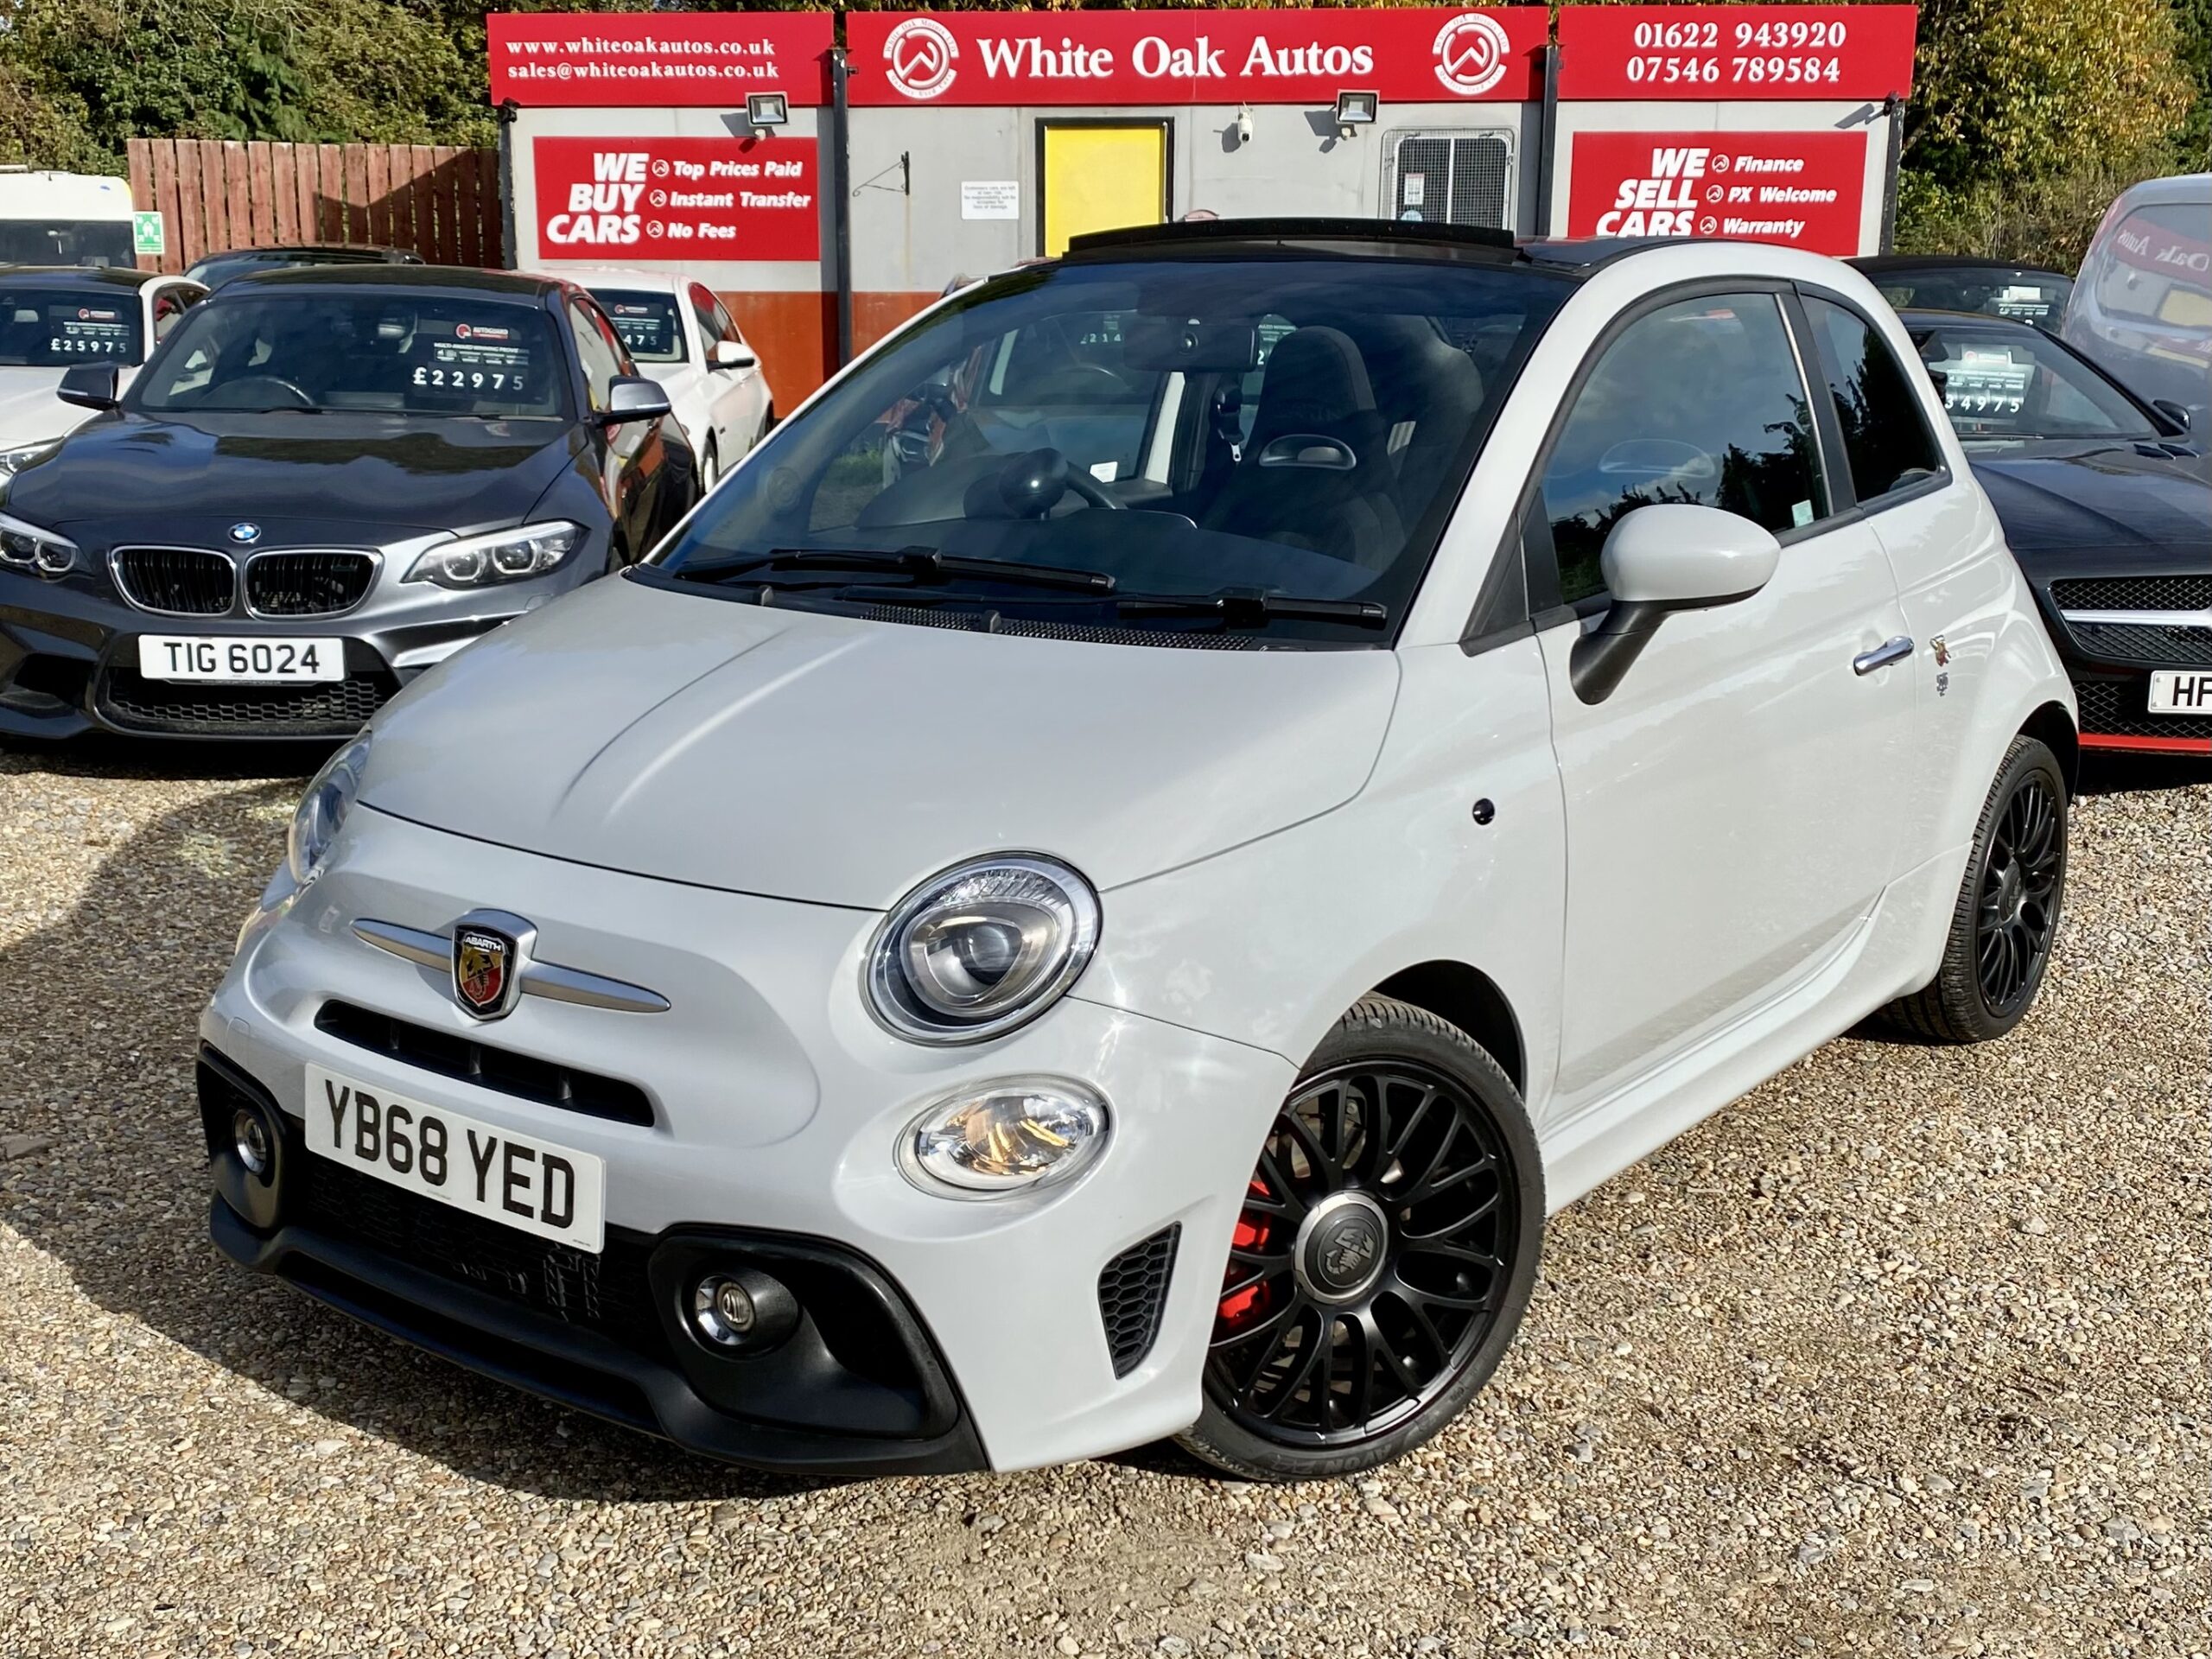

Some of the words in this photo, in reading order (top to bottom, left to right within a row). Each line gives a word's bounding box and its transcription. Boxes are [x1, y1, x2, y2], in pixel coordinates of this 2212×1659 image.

[506, 37, 775, 54] www.whiteoakautos.co.uk
[1634, 22, 1718, 48] 01622
[1735, 22, 1847, 48] 943920
[508, 61, 779, 79] sales@whiteoakautos.co.uk
[976, 37, 1114, 79] White
[1132, 36, 1227, 78] Oak
[1239, 36, 1374, 76] Autos
[1626, 56, 1719, 83] 07546
[1732, 56, 1840, 83] 789584
[594, 153, 650, 182] WE
[673, 161, 704, 180] Top
[709, 161, 760, 177] Prices
[764, 161, 802, 177] Paid
[1652, 148, 1710, 178] WE
[1734, 156, 1804, 173] Finance
[568, 184, 645, 213] BUY
[670, 192, 734, 207] Instant
[741, 191, 811, 208] Transfer
[1614, 180, 1698, 209] SELL
[1728, 187, 1754, 203] PX
[1759, 187, 1837, 203] Welcome
[546, 214, 641, 245] CARS
[667, 222, 694, 238] No
[698, 222, 736, 238] Fees
[1595, 211, 1695, 238] CARS
[1723, 218, 1806, 238] Warranty
[51, 338, 126, 353] £25975
[413, 366, 524, 391] £22975
[1944, 395, 2019, 413] 34975
[163, 642, 216, 672] TIG
[228, 644, 320, 674] 6024
[465, 936, 502, 951] ABARTH
[325, 1079, 448, 1186] YB68
[467, 1128, 575, 1229] YED
